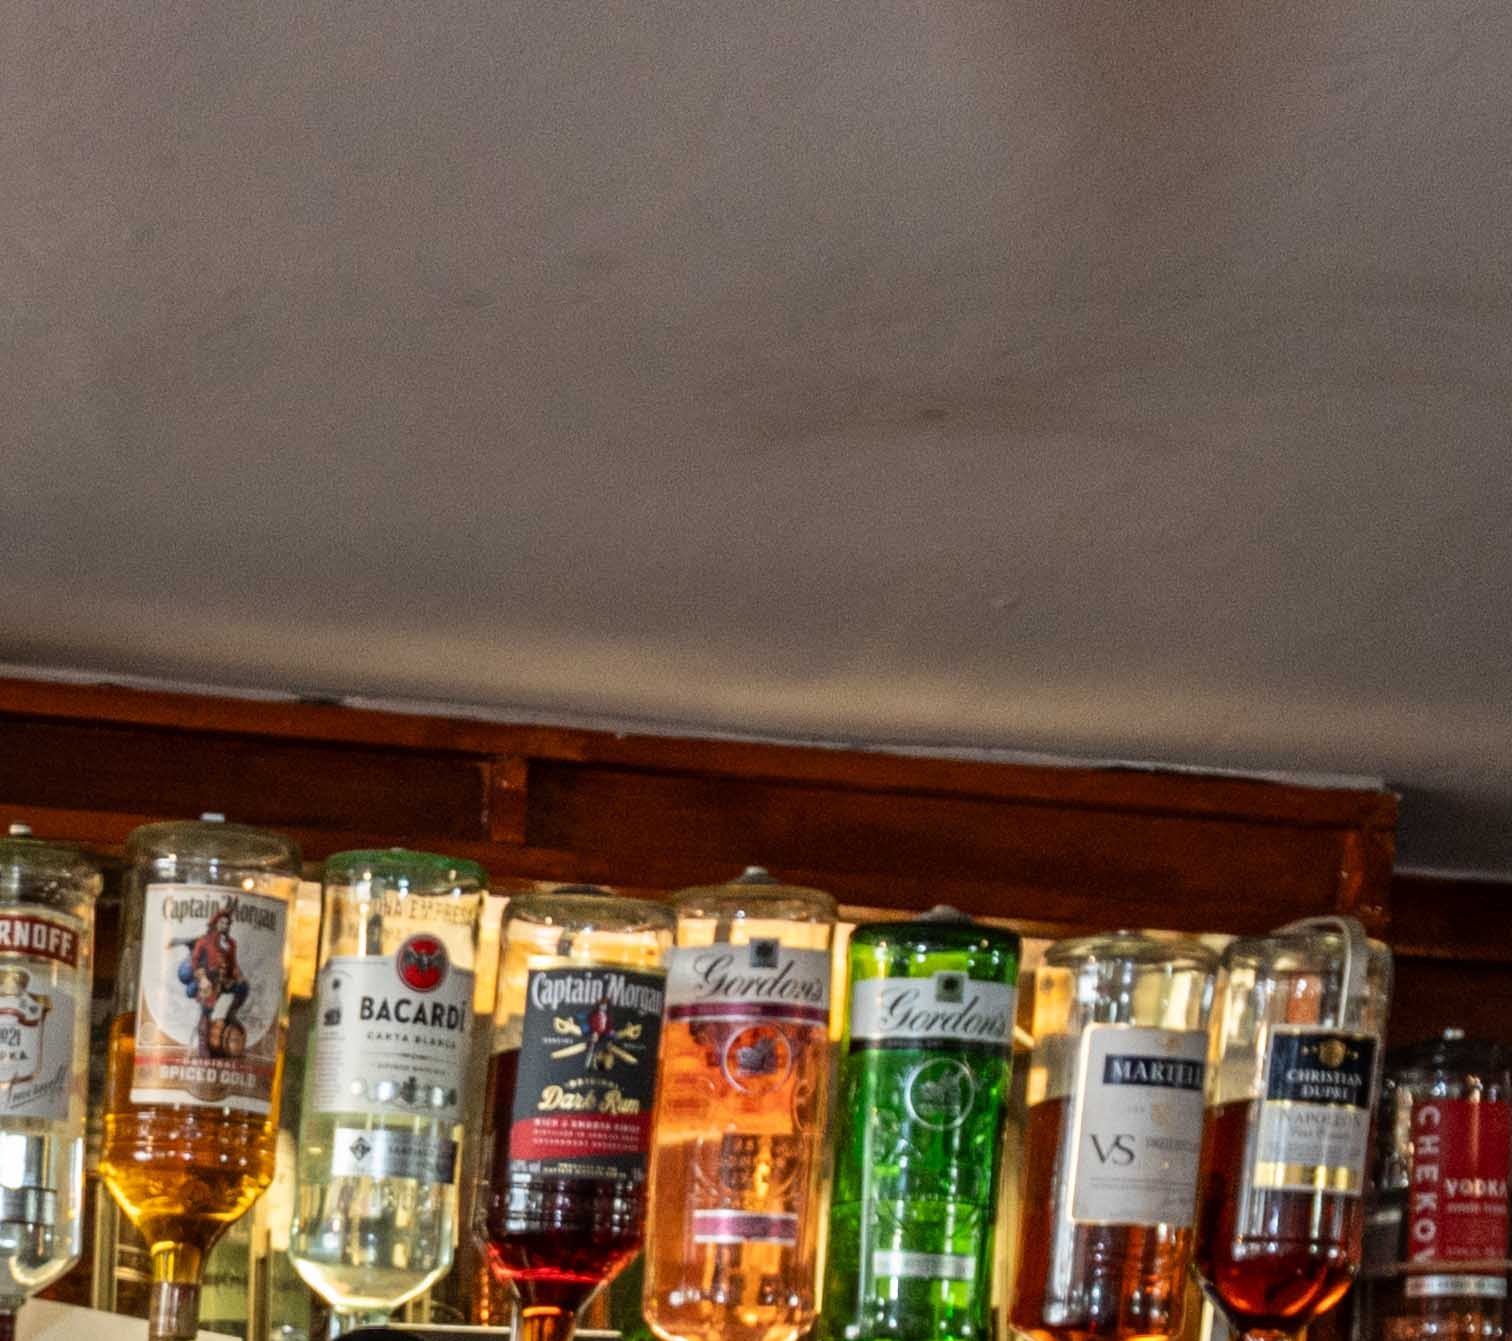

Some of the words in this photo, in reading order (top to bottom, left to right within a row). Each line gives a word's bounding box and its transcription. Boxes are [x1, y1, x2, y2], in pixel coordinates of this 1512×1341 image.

[163, 896, 219, 923] Captain
[693, 953, 823, 1001] Gordon's
[532, 972, 602, 1010] Captain
[605, 974, 662, 1016] Morgan
[881, 986, 1006, 1037] Gordon's
[160, 1066, 216, 1082] SPICED
[220, 1071, 256, 1087] GOLD
[1286, 1069, 1363, 1085] CHRISTIAN
[538, 1085, 596, 1111] Dark
[599, 1090, 640, 1115] Rum
[1091, 1134, 1136, 1165] VS
[1445, 1178, 1506, 1197] VODKA
